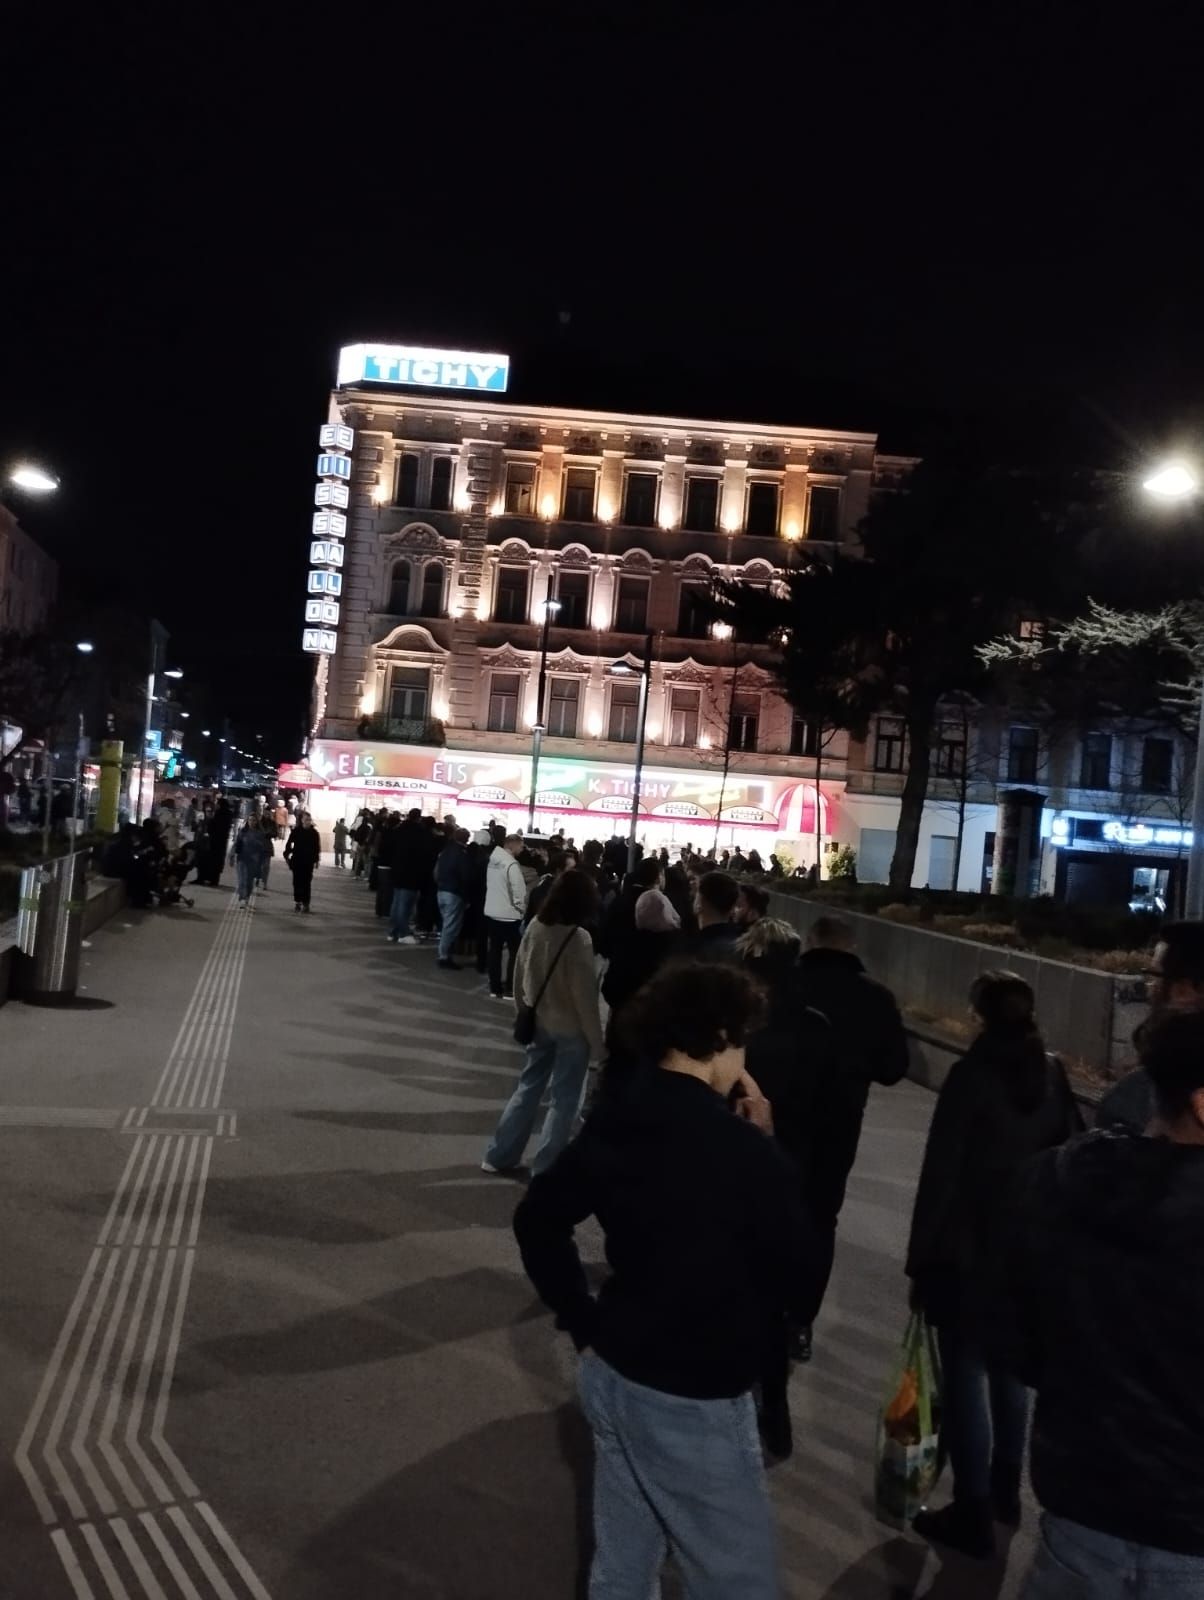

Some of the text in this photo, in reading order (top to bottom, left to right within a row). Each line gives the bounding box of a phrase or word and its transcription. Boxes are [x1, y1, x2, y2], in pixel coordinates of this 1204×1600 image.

[372, 356, 498, 388] TICHY
[304, 425, 337, 651] EISSALON
[320, 425, 353, 653] EISSALON
[338, 754, 375, 776] EIS
[432, 762, 467, 784] EIS
[364, 779, 428, 790] EISSALON
[588, 778, 671, 798] K. TICHY
